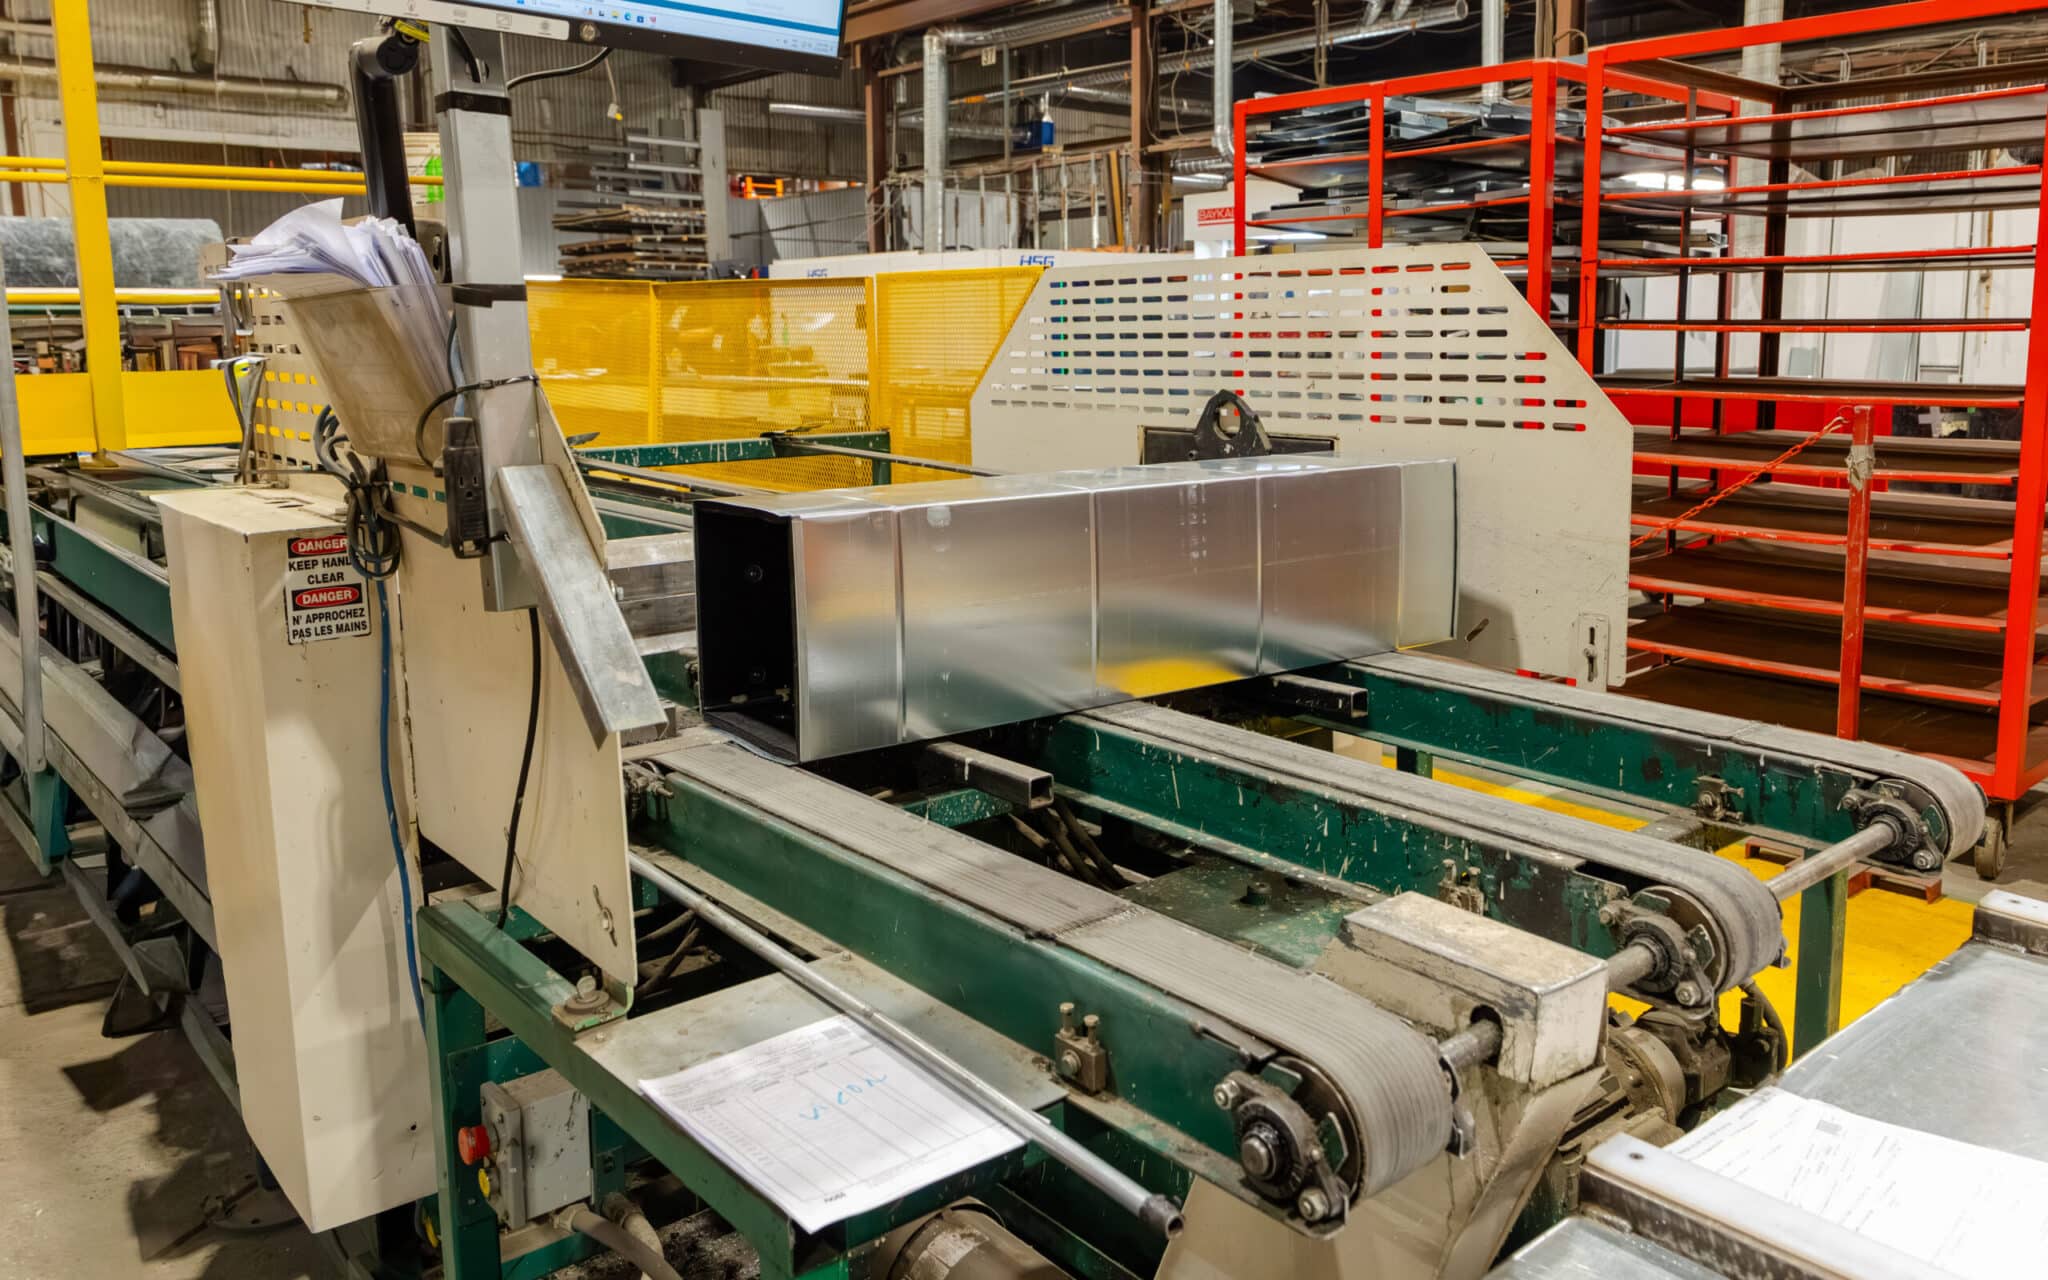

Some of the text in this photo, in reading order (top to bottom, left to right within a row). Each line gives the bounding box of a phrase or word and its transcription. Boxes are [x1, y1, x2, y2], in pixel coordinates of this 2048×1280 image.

[298, 539, 349, 552] DANGER
[288, 560, 319, 572] KEEP
[307, 572, 344, 585] CLEAR
[302, 589, 352, 605] DANGER
[292, 608, 365, 626] N' APPROCHEZ
[292, 621, 368, 640] PAS LES MAINS
